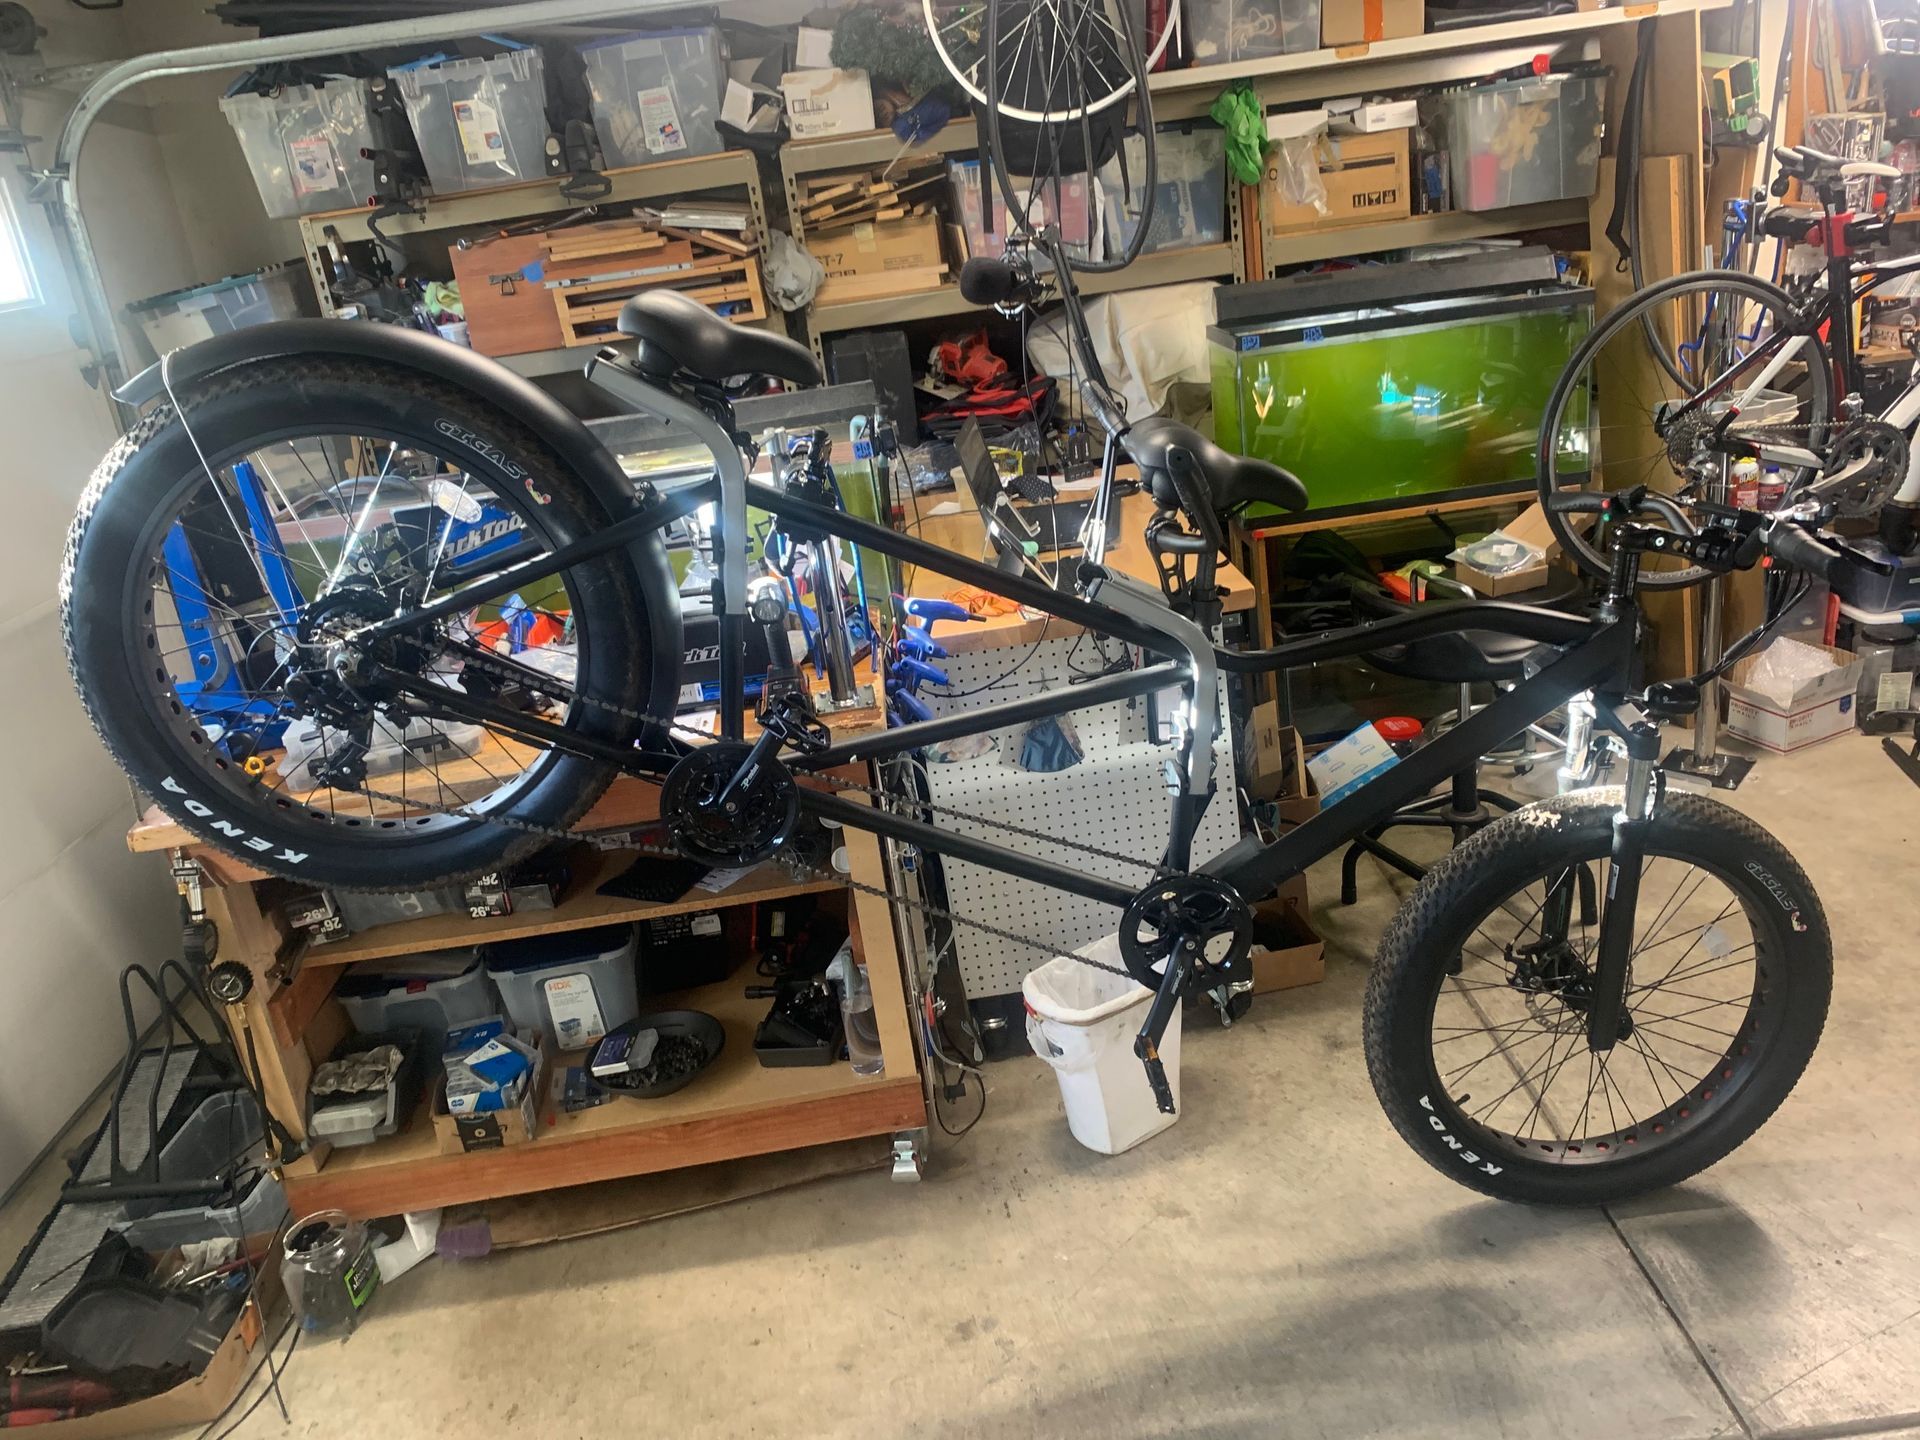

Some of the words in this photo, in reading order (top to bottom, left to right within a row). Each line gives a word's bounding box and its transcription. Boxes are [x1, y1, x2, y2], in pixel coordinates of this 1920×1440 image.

[160, 775, 309, 864] KENDA
[303, 907, 326, 922] 26"
[469, 906, 490, 918] 26"
[320, 916, 343, 933] 26"
[548, 979, 572, 992] HDX
[1418, 1095, 1504, 1176] KENDA
